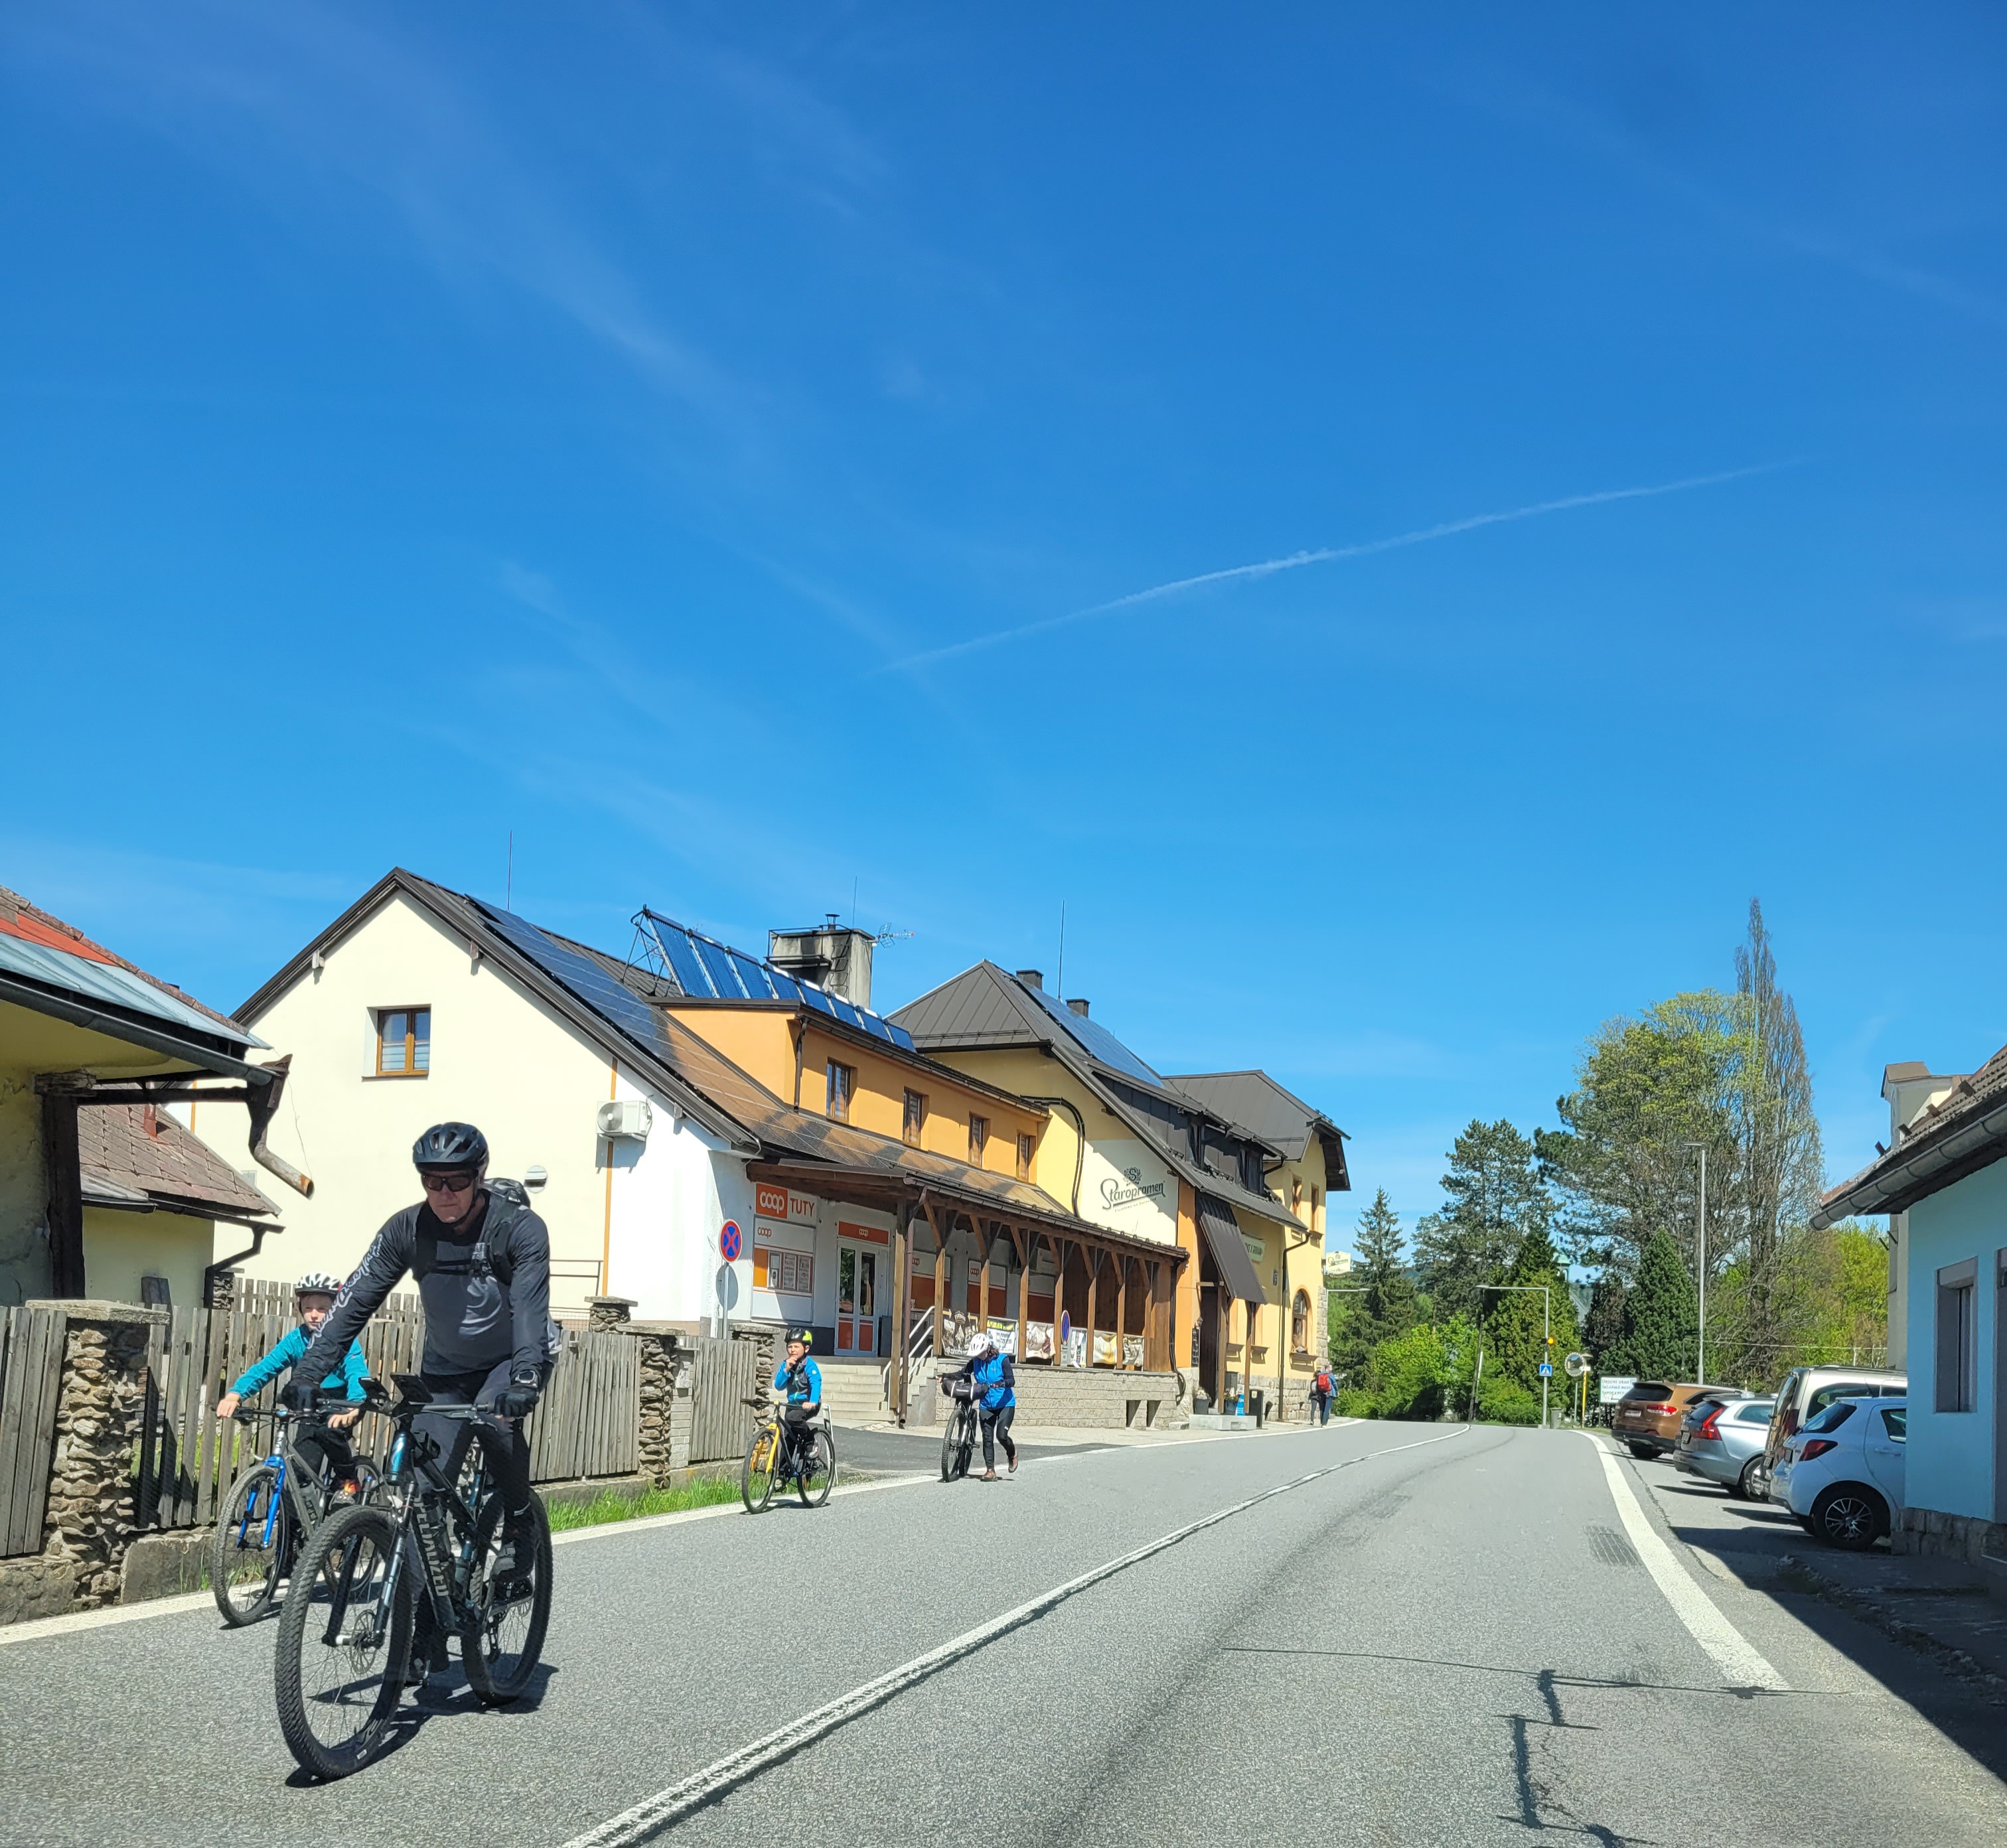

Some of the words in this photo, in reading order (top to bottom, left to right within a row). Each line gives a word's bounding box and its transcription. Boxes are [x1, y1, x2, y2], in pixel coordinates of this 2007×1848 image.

[1100, 1178, 1166, 1210] Staropramen
[759, 1191, 785, 1214] coop
[790, 1198, 815, 1217] TUTY
[757, 1226, 772, 1239] coop
[911, 1257, 920, 1267] oop
[970, 1267, 980, 1277] coop
